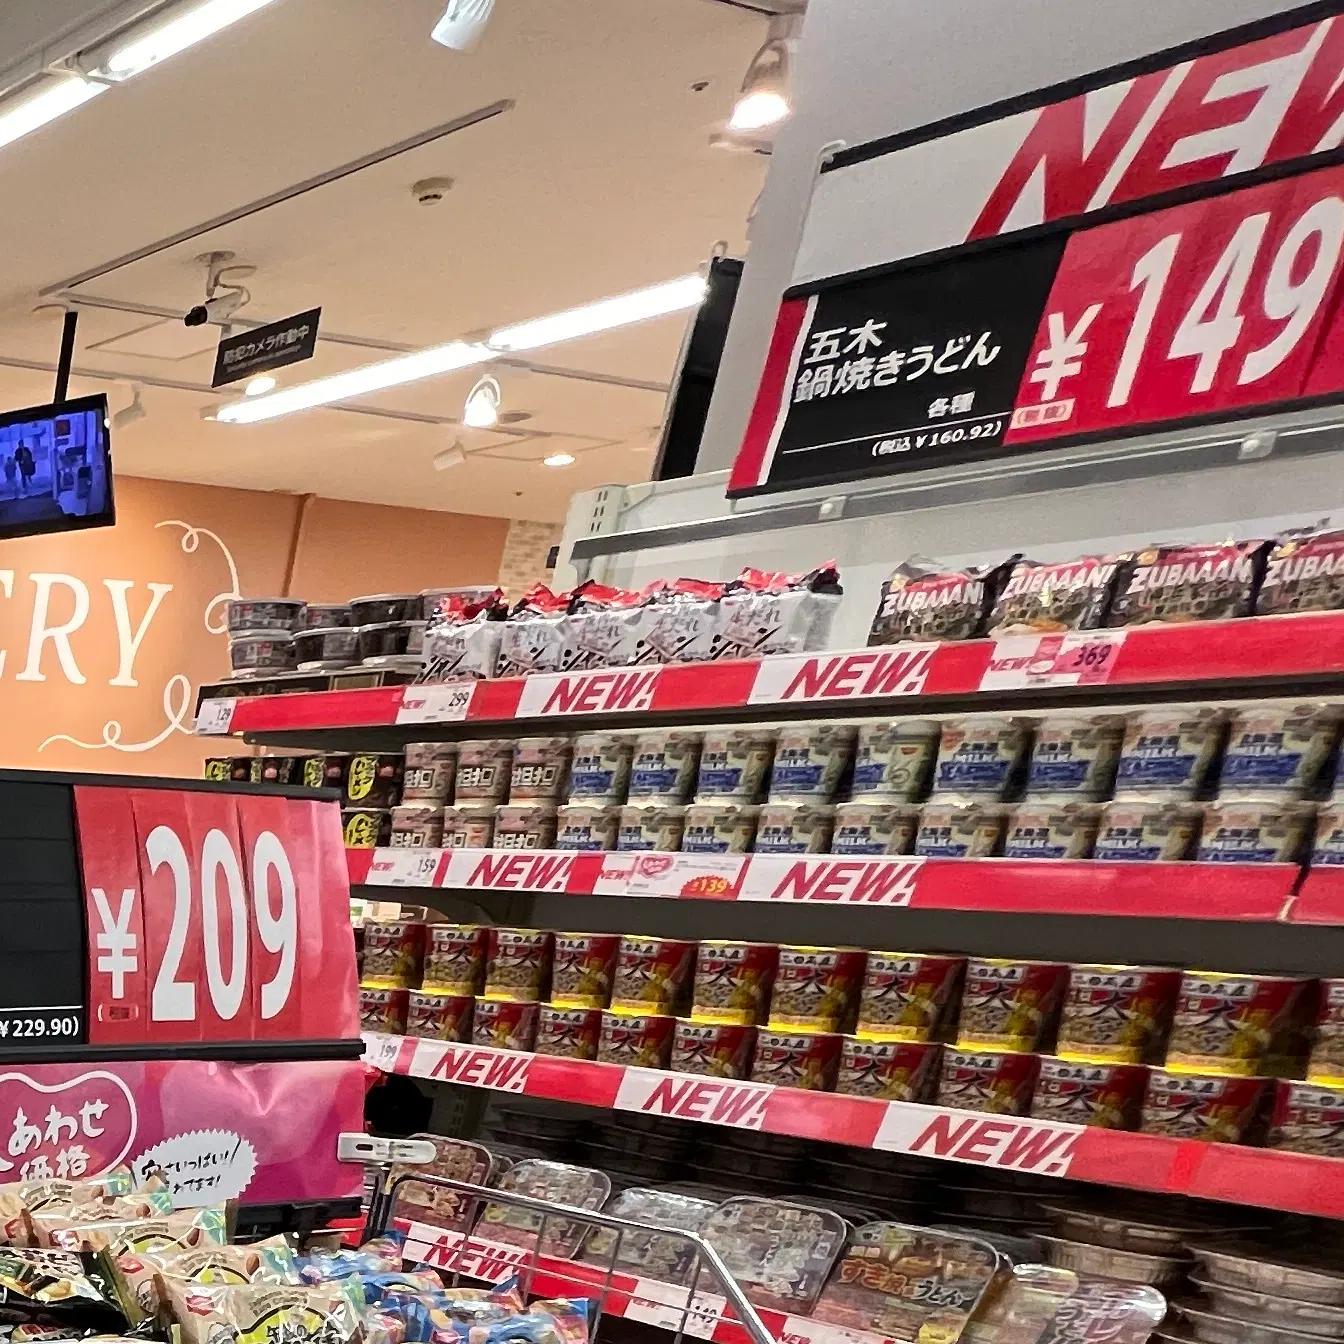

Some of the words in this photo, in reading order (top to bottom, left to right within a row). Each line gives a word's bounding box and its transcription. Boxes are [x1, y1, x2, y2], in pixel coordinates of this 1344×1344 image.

[807, 318, 889, 364] 五木
[792, 330, 1002, 403] 鍋焼きうどん
[926, 391, 976, 418] 各種
[782, 649, 934, 700] NEW!
[1072, 644, 1111, 668] 369
[542, 669, 657, 713] NEW!
[467, 854, 571, 890] NEW!
[771, 862, 920, 903] NEW!
[431, 1047, 527, 1089] NEW!
[641, 1078, 768, 1124] NEW!
[18, 1142, 91, 1182] 価格
[909, 1115, 1077, 1173] NEW!
